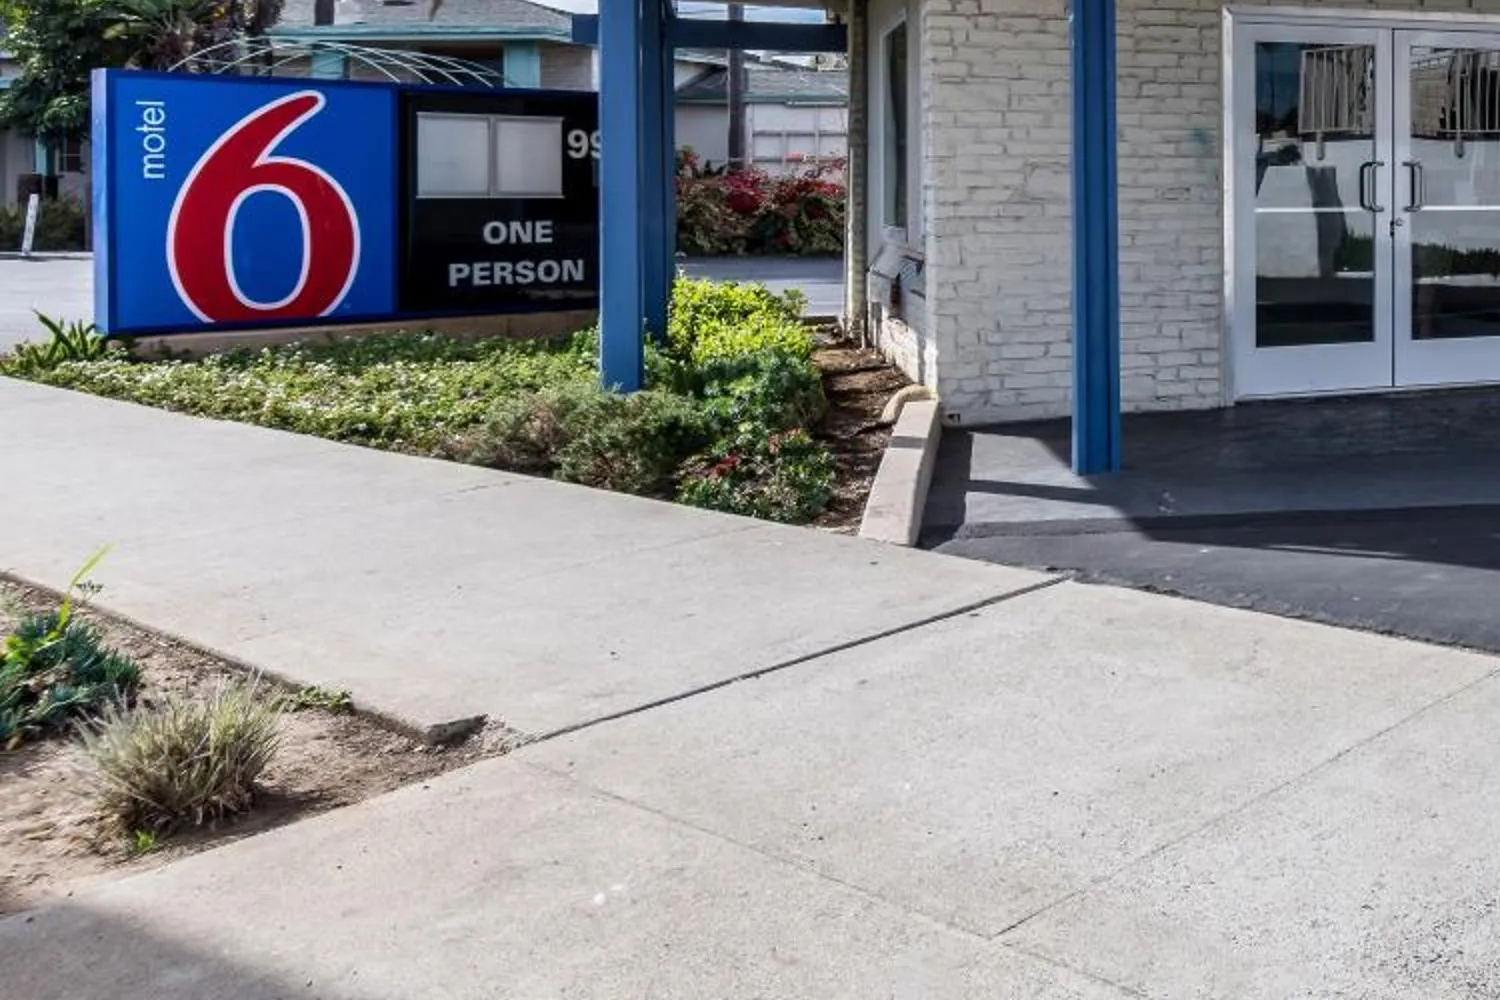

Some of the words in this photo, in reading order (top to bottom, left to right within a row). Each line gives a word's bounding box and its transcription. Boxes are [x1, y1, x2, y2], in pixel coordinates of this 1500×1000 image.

[135, 100, 165, 179] motel
[166, 90, 361, 322] 6
[483, 220, 553, 245] ONE
[448, 259, 584, 287] PERSON
